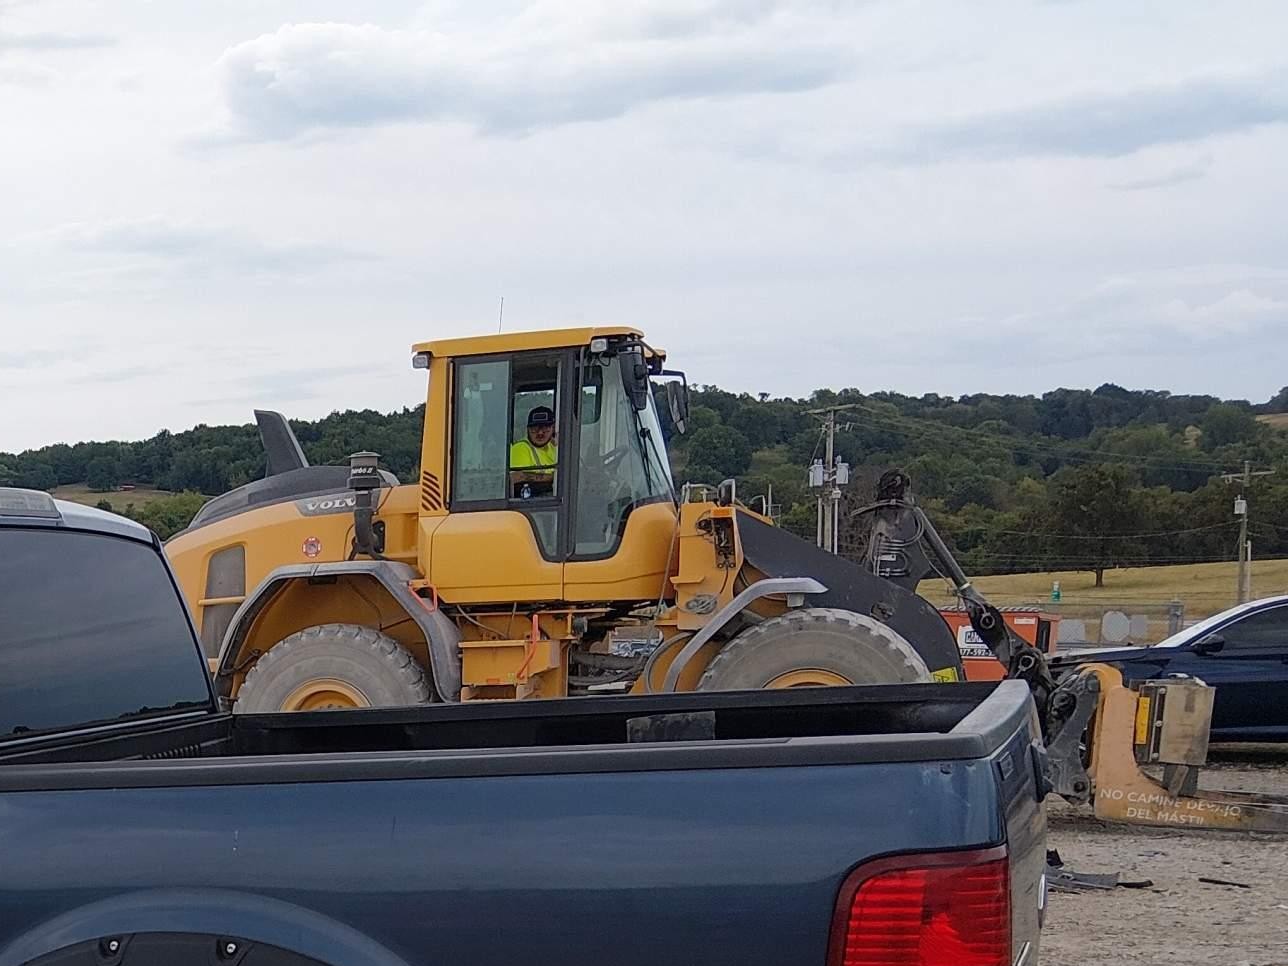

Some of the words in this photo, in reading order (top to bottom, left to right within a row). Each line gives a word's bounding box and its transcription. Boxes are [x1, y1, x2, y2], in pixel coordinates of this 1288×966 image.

[306, 497, 357, 511] VOLV
[1100, 788, 1123, 801] NO
[1127, 791, 1183, 808] CAMINE
[1126, 807, 1153, 820] DEL
